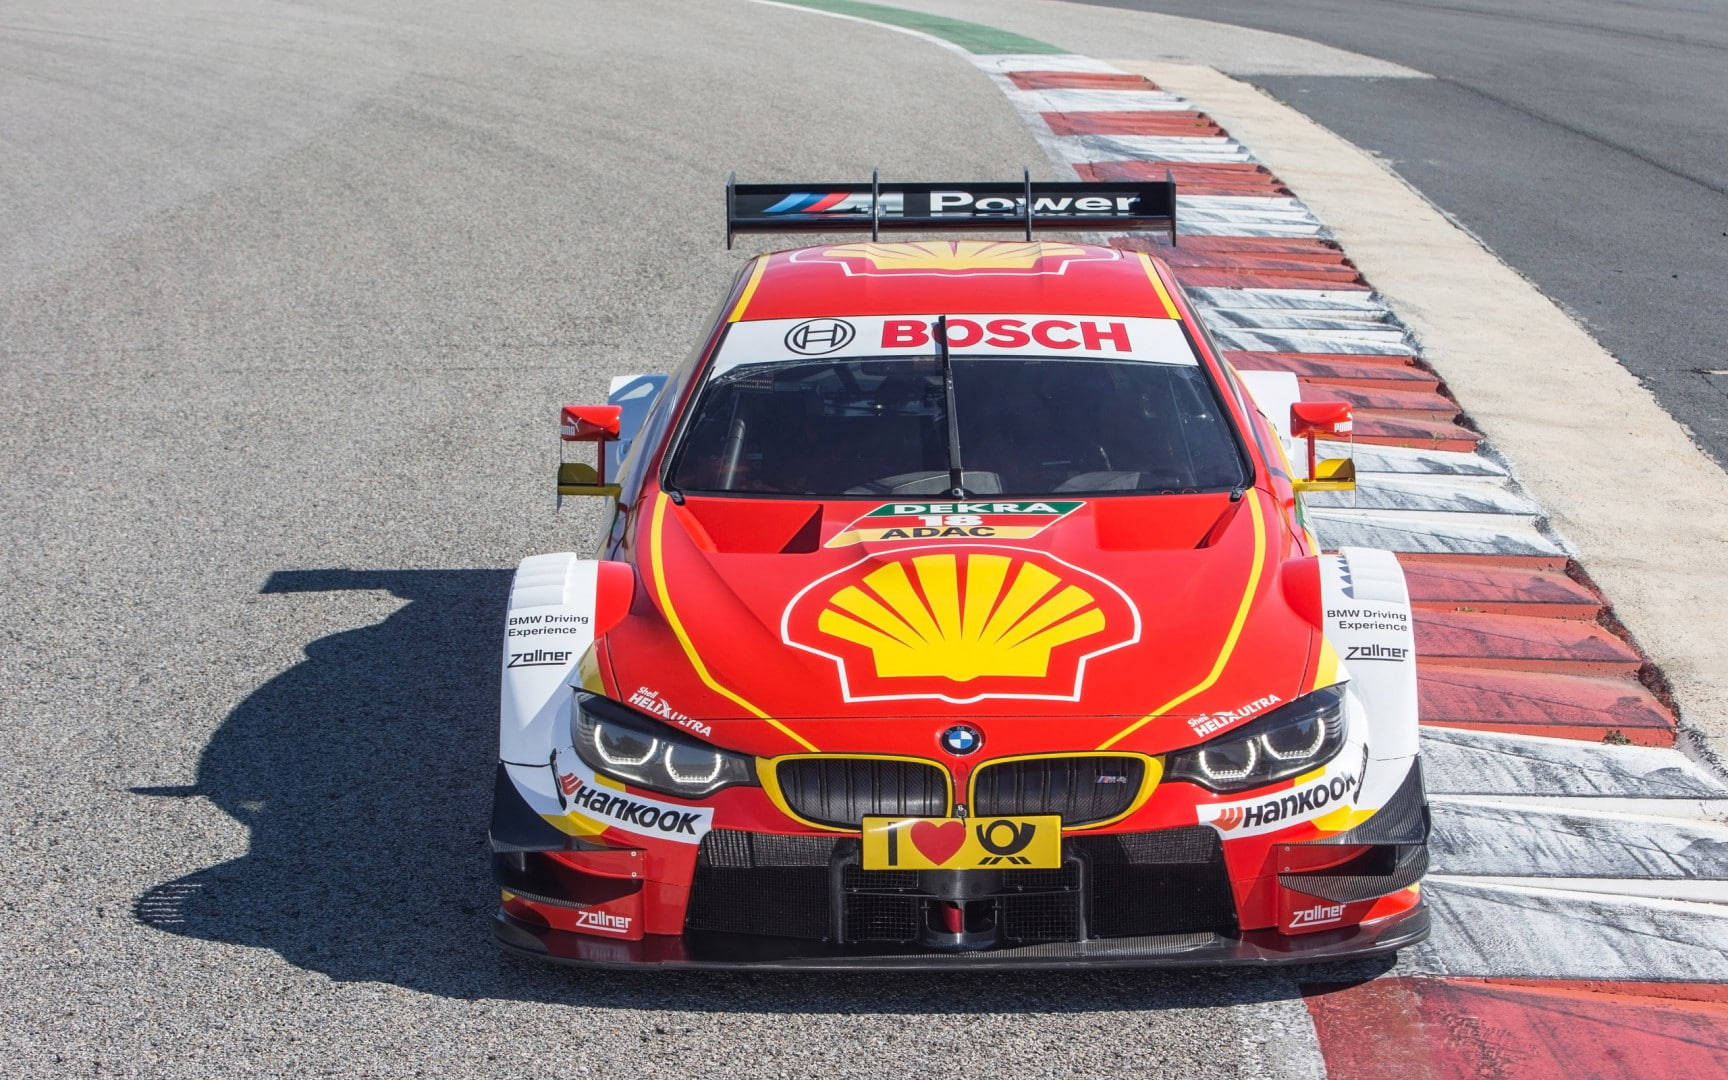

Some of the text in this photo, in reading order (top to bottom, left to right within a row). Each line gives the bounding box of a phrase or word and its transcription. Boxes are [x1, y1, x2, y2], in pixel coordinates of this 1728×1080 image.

[929, 191, 1139, 212] Power
[881, 318, 1132, 353] BOSCH
[894, 502, 1059, 515] DEKRA
[918, 515, 984, 527] 18
[879, 526, 996, 540] ADAC
[509, 614, 589, 626] BMW Driving
[1327, 609, 1407, 622] BMW Driving
[508, 626, 577, 637] Experience
[1339, 620, 1408, 632] Experience
[637, 686, 659, 699] Shell
[628, 693, 712, 737] HELIX ULTRA
[1187, 713, 1210, 728] Shell
[1193, 693, 1282, 738] HELIX ULTRA
[888, 822, 898, 866] I
